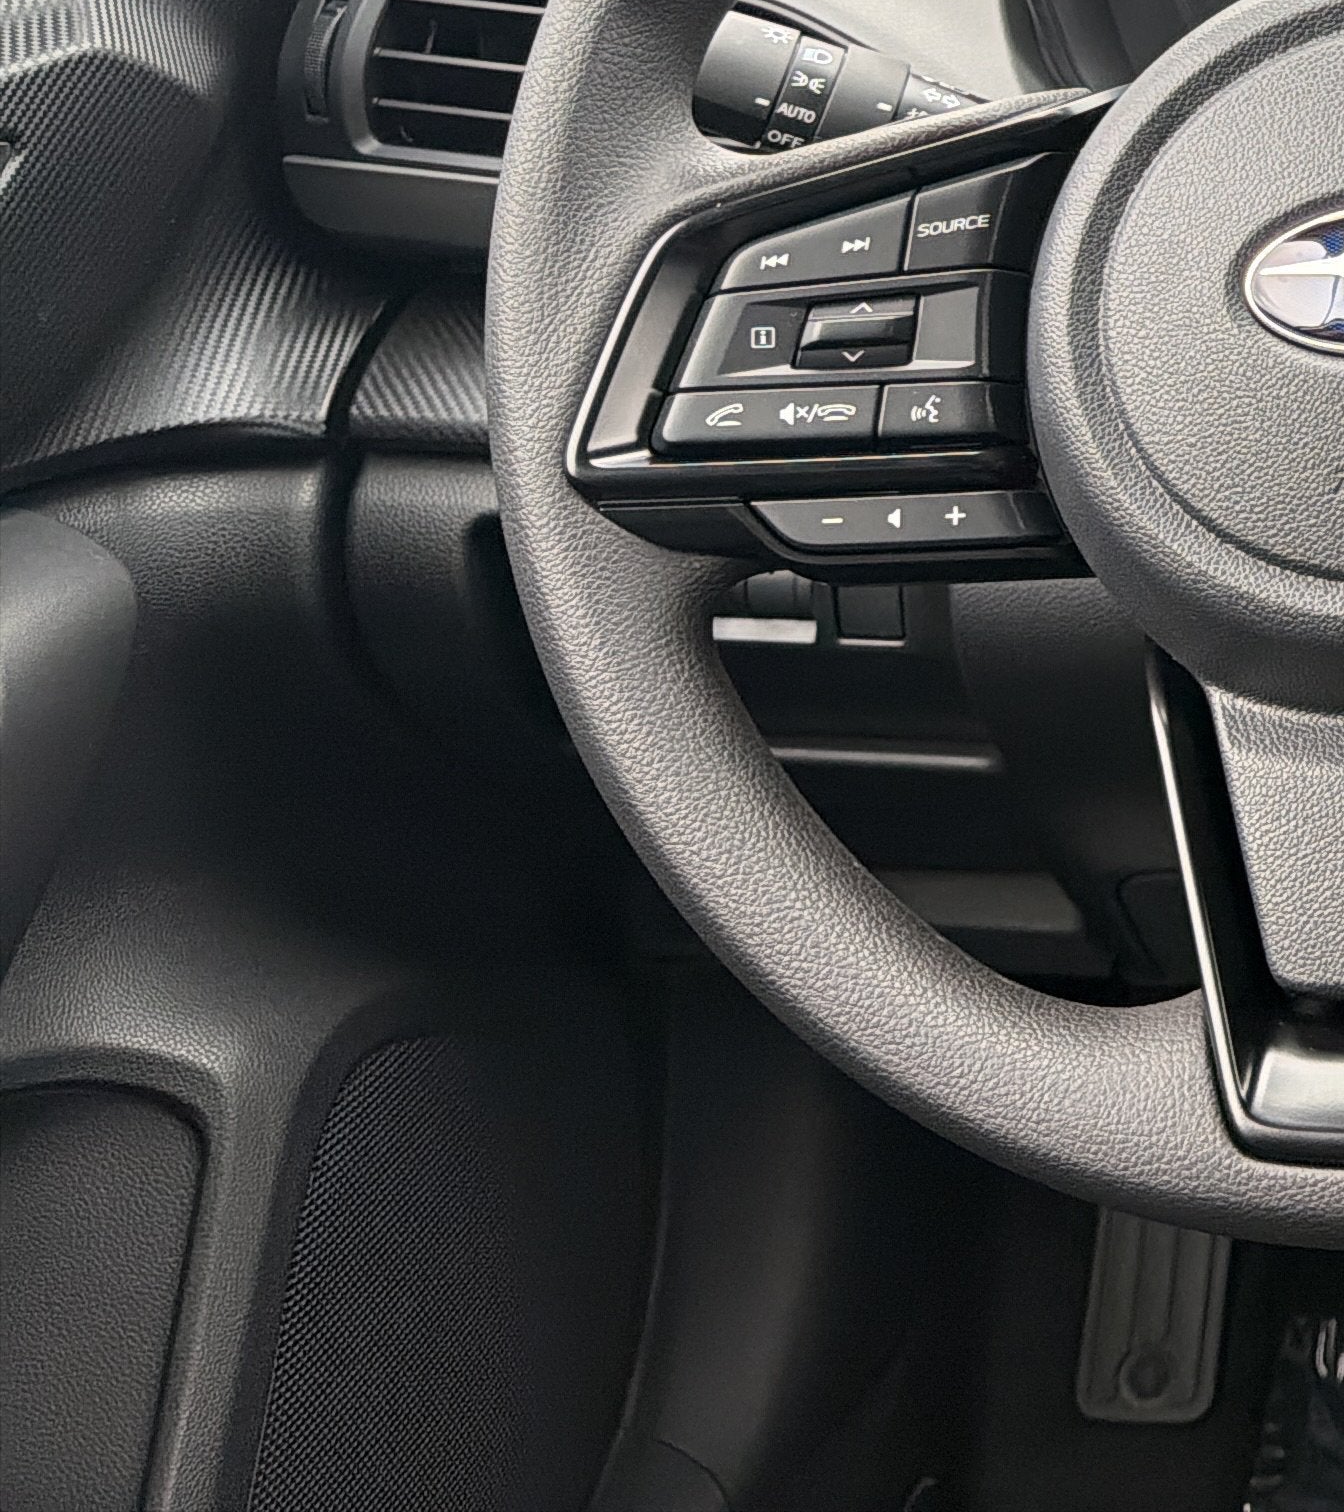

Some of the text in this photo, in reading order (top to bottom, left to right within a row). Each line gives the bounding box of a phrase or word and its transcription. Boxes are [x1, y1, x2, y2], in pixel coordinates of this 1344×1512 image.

[776, 102, 817, 124] AUTO
[767, 129, 805, 148] OFF
[916, 213, 992, 238] SOURCE
